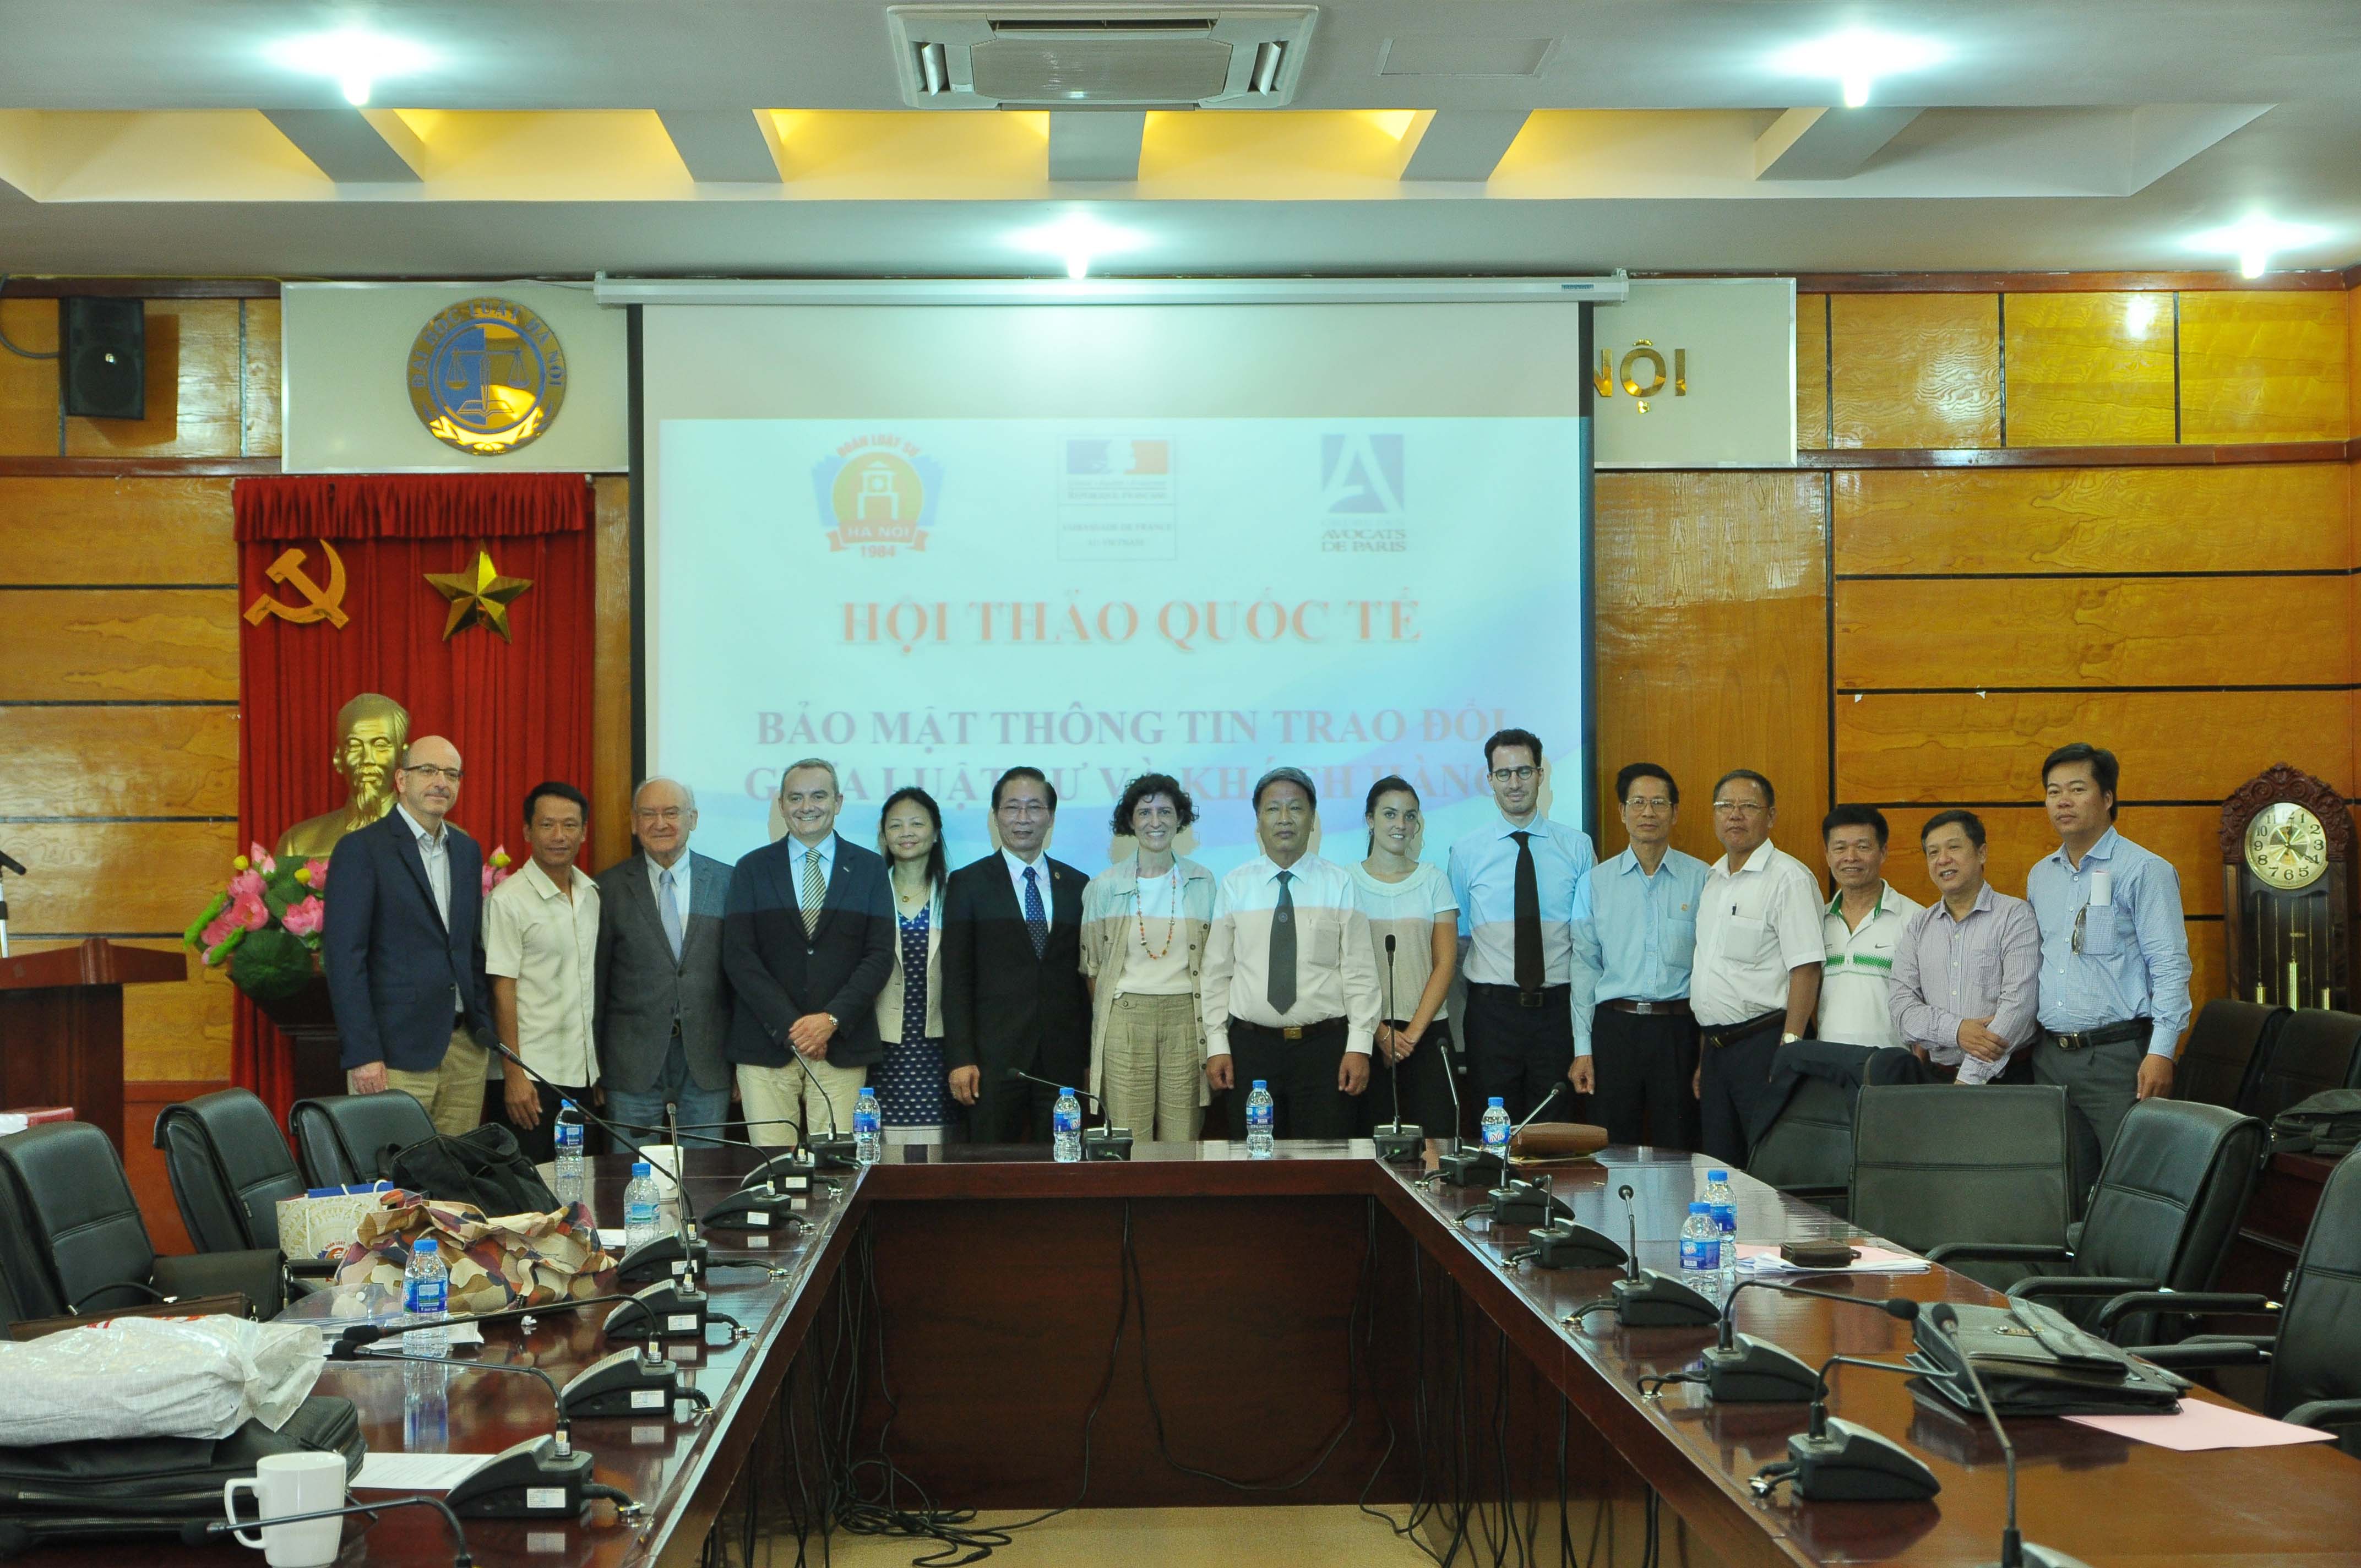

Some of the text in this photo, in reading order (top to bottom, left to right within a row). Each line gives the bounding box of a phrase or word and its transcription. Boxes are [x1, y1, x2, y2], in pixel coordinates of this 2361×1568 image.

[1321, 529, 1406, 539] AVOCATS
[1321, 541, 1407, 552] DE PARIS
[837, 586, 1422, 657] HỘI THẢO QUỐC TẾ
[757, 700, 856, 744] BẢO
[871, 706, 977, 754] MẬT
[991, 701, 1166, 745] THÔNG
[1177, 709, 1260, 744] TIN
[1272, 709, 1406, 743] TRAO
[745, 762, 869, 801] GA
[2266, 814, 2276, 824] 11
[2300, 813, 2305, 824] 1
[2256, 825, 2267, 836] 10
[2310, 824, 2321, 835] 2
[2254, 841, 2263, 851] 9
[2314, 839, 2324, 851] 3
[2257, 854, 2267, 865] 8
[2268, 866, 2278, 877] 7
[2284, 869, 2294, 880] 6
[2299, 866, 2309, 877] 5
